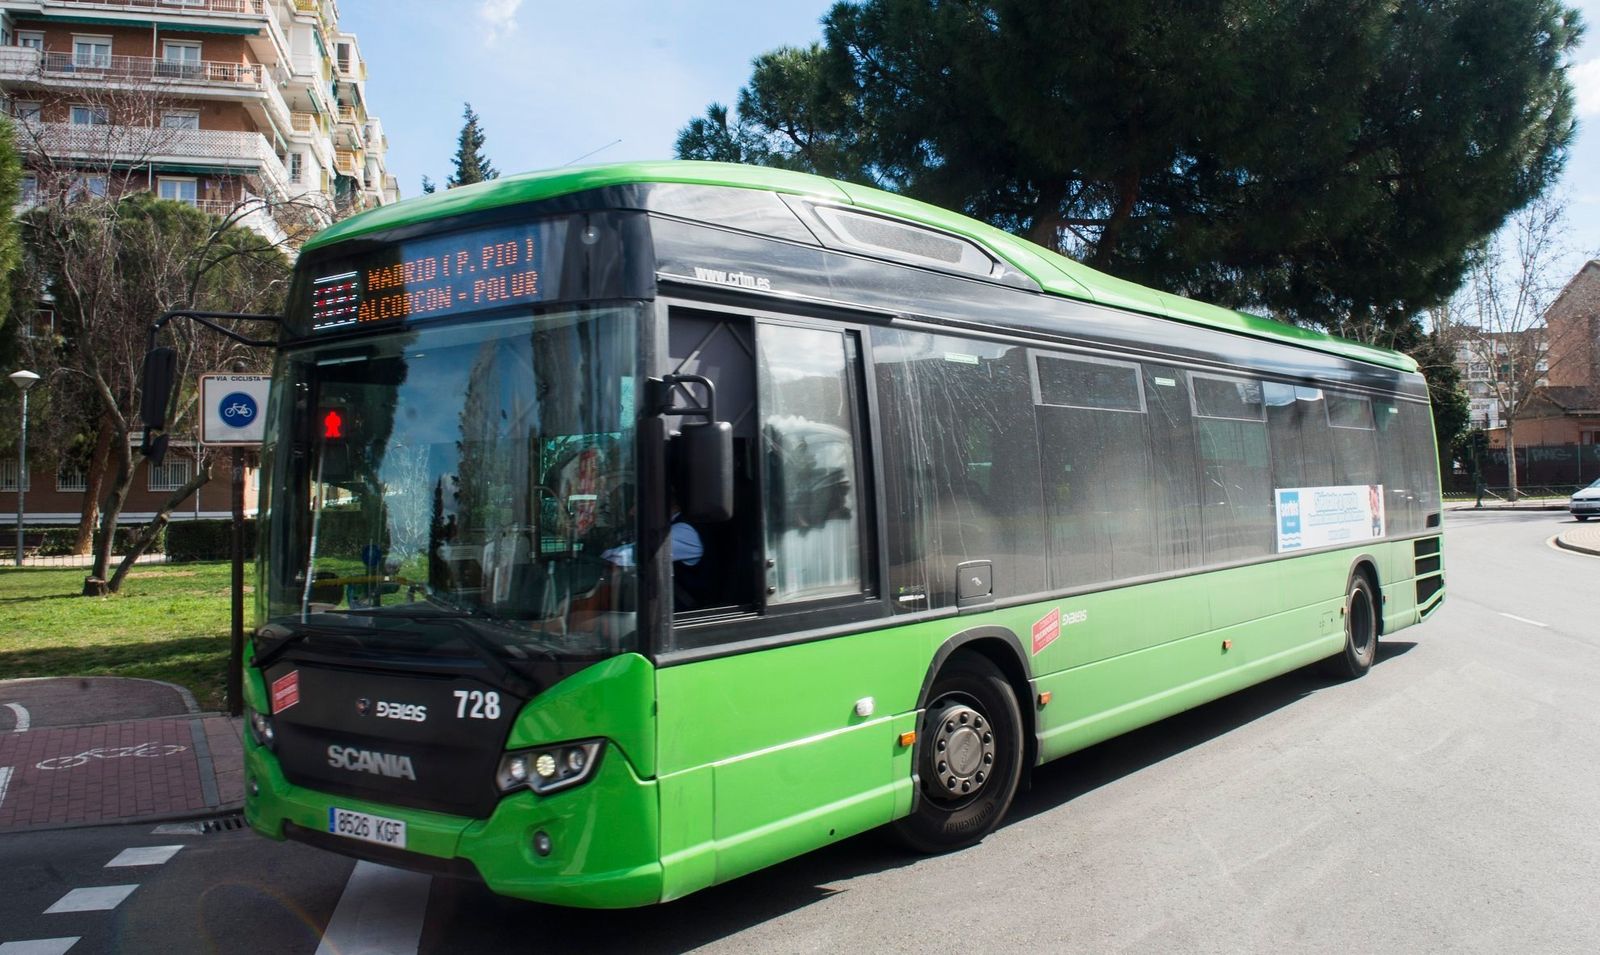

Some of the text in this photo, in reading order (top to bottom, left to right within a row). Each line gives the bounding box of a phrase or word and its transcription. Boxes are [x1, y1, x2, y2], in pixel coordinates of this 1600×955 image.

[368, 257, 437, 291] MADRID
[358, 286, 452, 323] ALCORCON
[453, 690, 500, 720] 728
[327, 744, 416, 781] SCANIA
[338, 812, 402, 843] 8526 KGF
